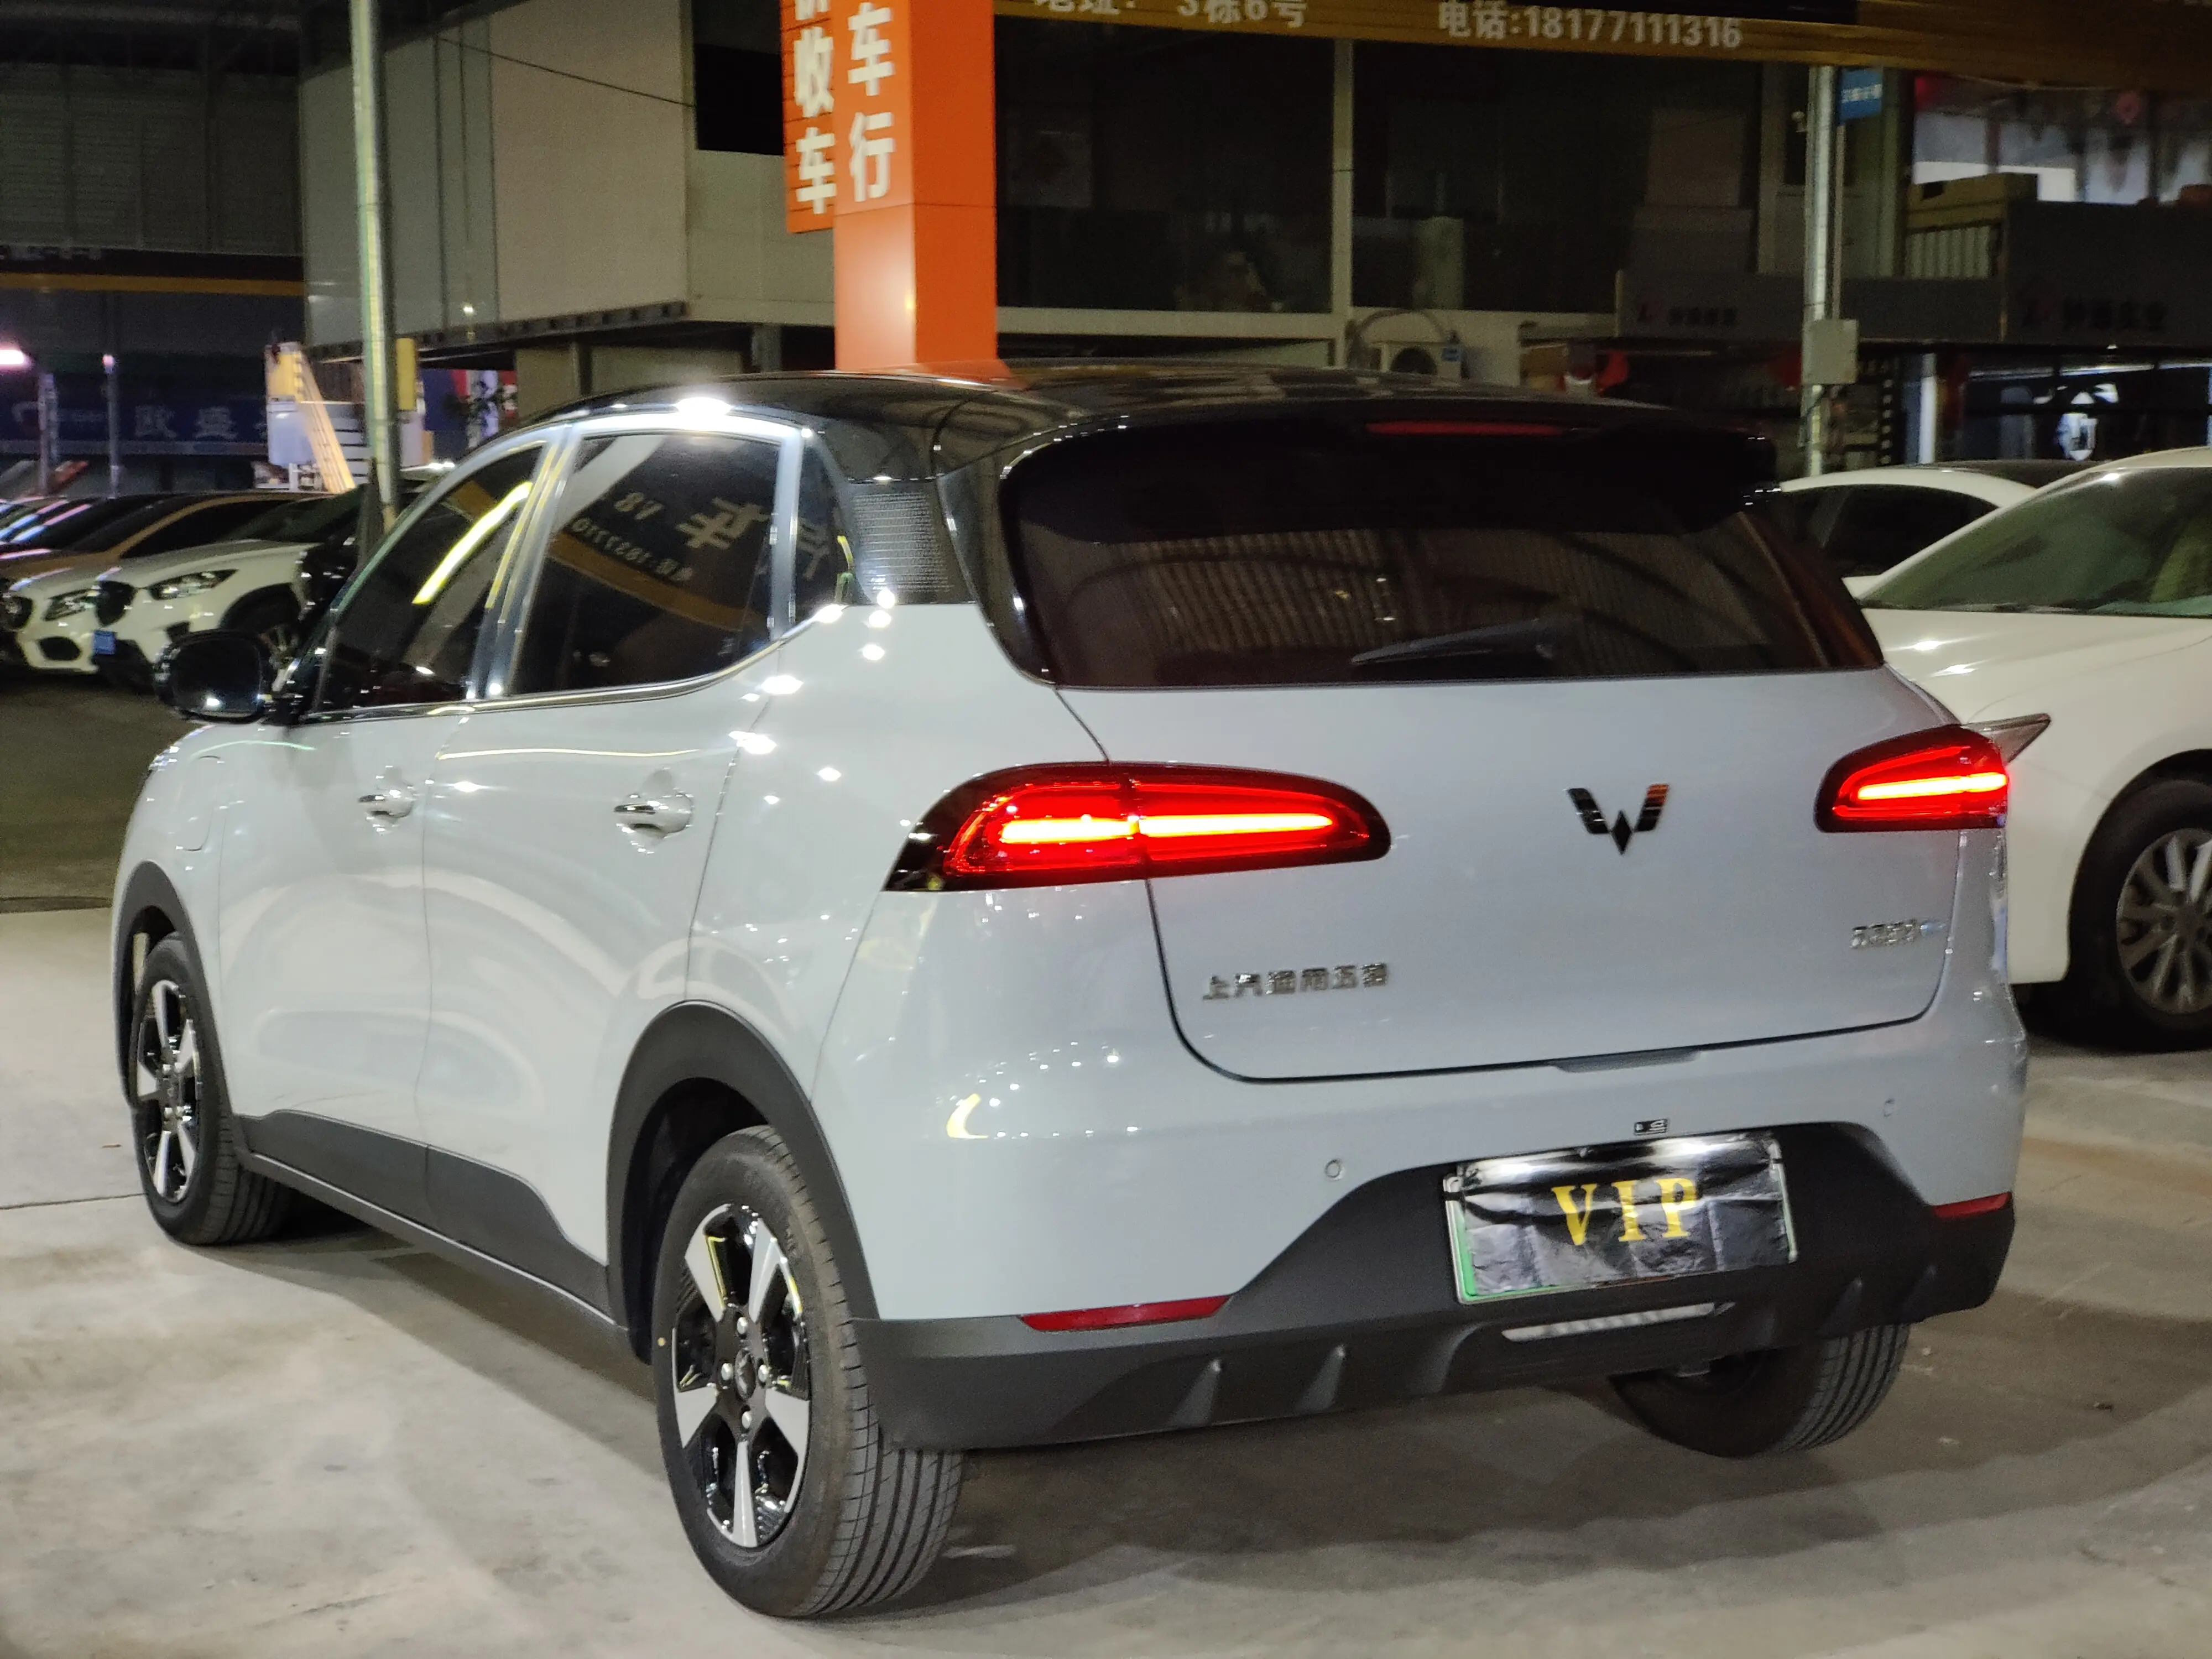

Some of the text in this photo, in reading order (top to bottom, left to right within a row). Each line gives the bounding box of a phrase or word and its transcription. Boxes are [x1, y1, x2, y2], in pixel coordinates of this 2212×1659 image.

[794, 0, 836, 215] 收车
[848, 2, 895, 202] 车行
[1551, 1177, 1697, 1246] VIP
